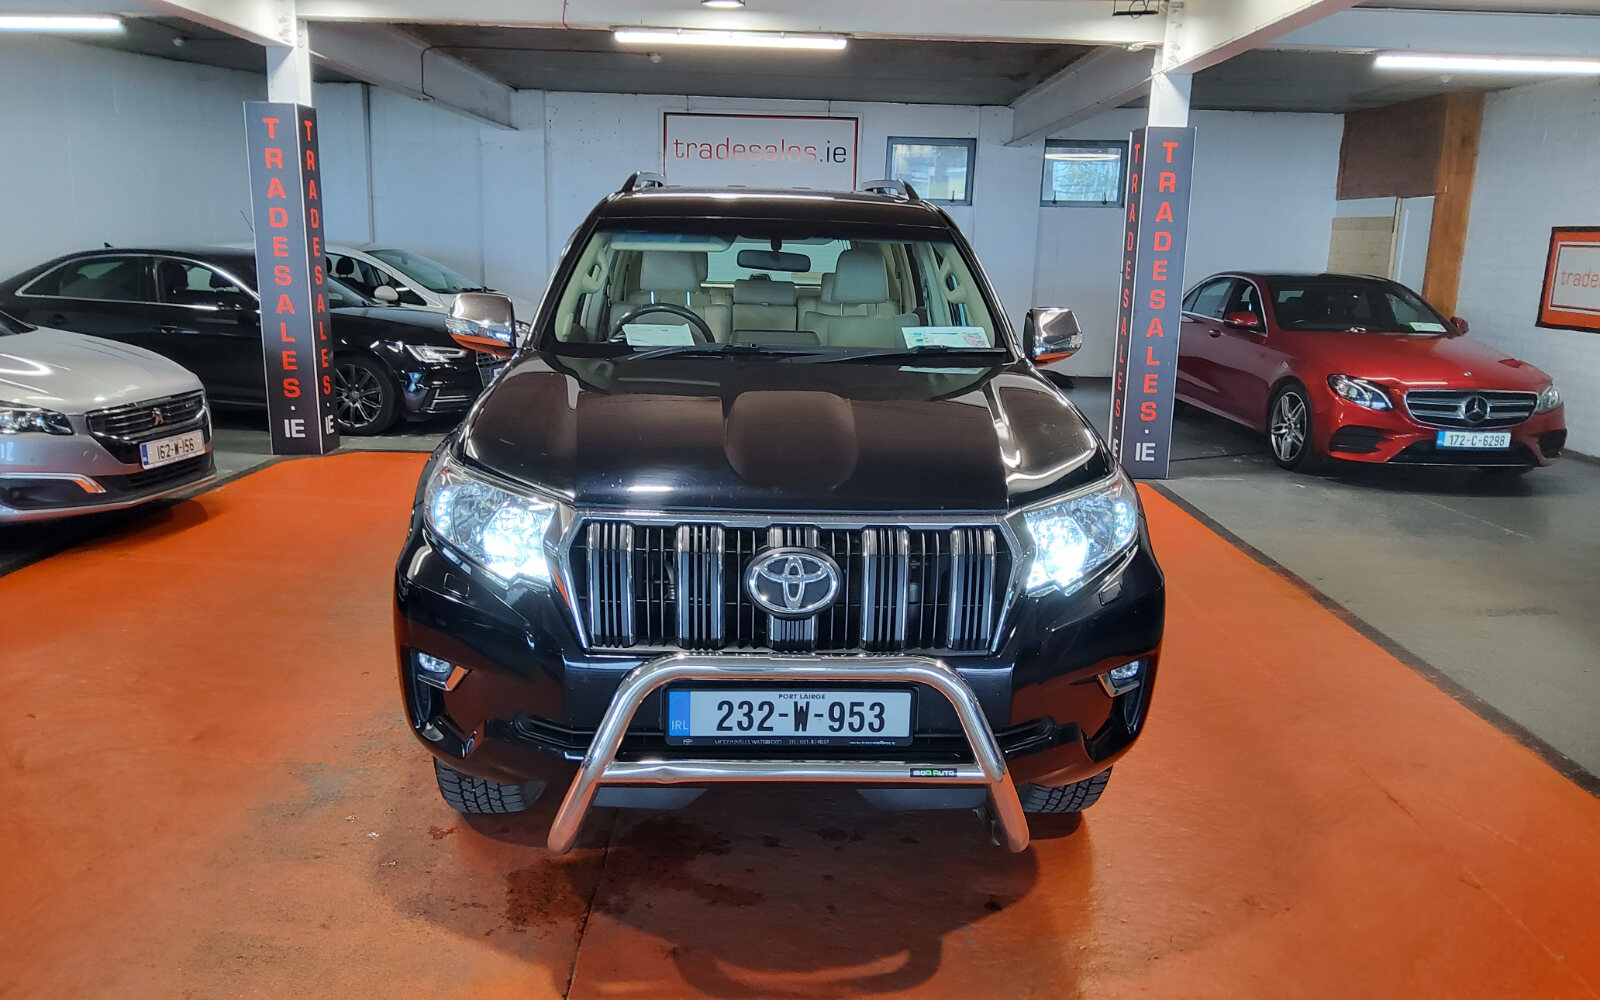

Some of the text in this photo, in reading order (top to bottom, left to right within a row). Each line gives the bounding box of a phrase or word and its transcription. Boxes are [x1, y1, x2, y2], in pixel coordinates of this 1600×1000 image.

[673, 137, 847, 164] tradesales.ie
[262, 117, 306, 438] TRADESALES.IE
[1560, 269, 1600, 288] trade
[1135, 141, 1179, 461] TRADESALES.IE
[1449, 434, 1506, 447] 172-C-6298
[671, 720, 689, 731] IRL
[715, 699, 886, 733] 232-W-953
